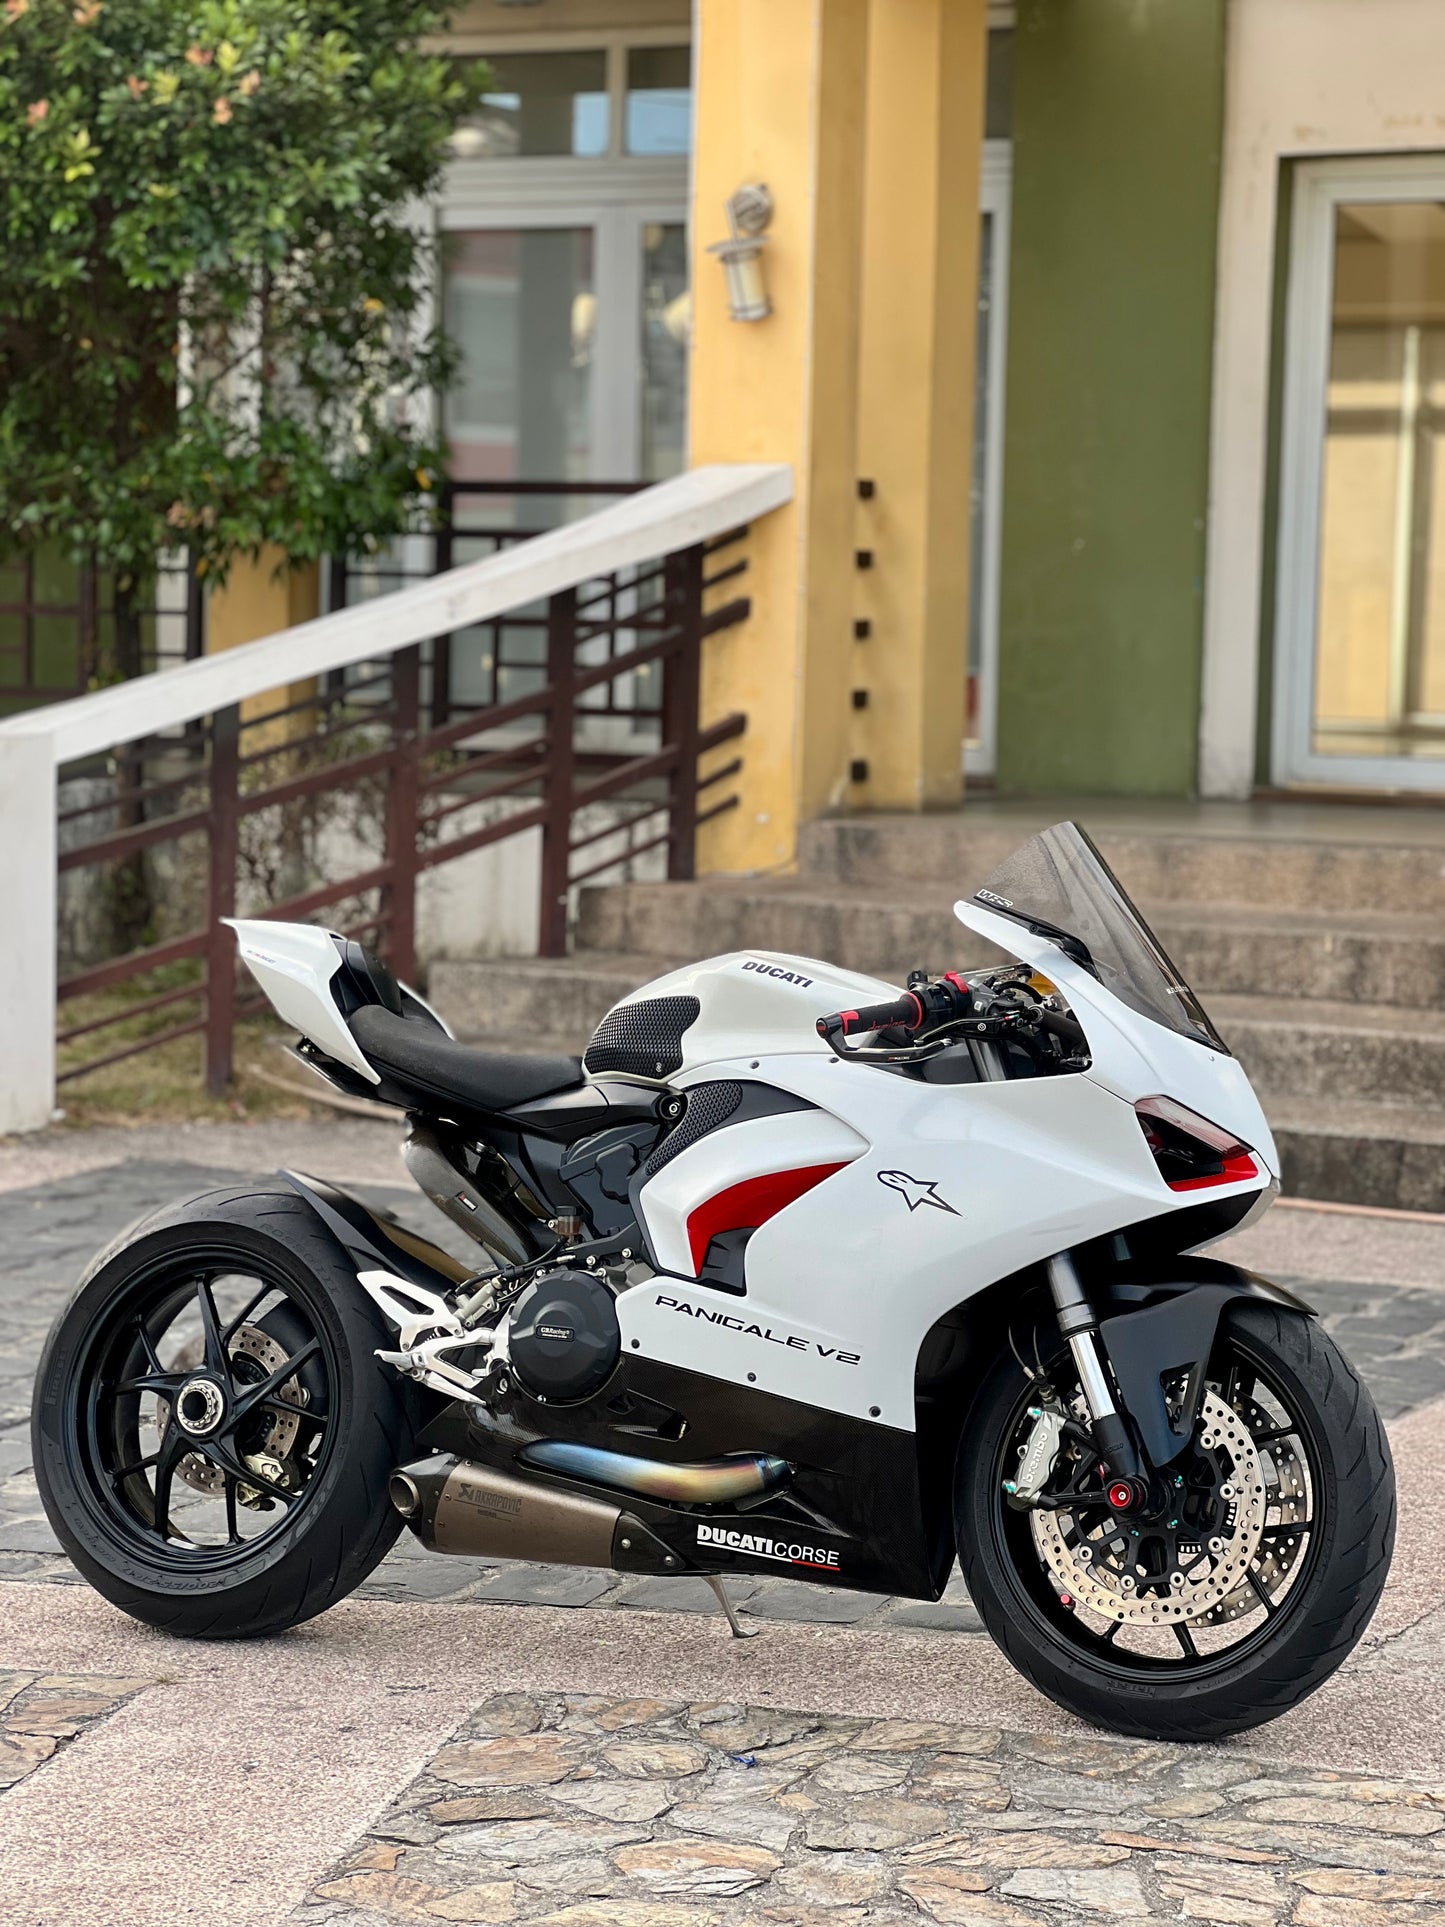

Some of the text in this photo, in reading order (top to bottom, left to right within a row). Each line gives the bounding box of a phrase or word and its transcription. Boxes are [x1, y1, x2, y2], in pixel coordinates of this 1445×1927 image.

[741, 961, 814, 988] DUCATI
[655, 1295, 861, 1365] PANIGALE V2
[1022, 1432, 1048, 1483] brembo
